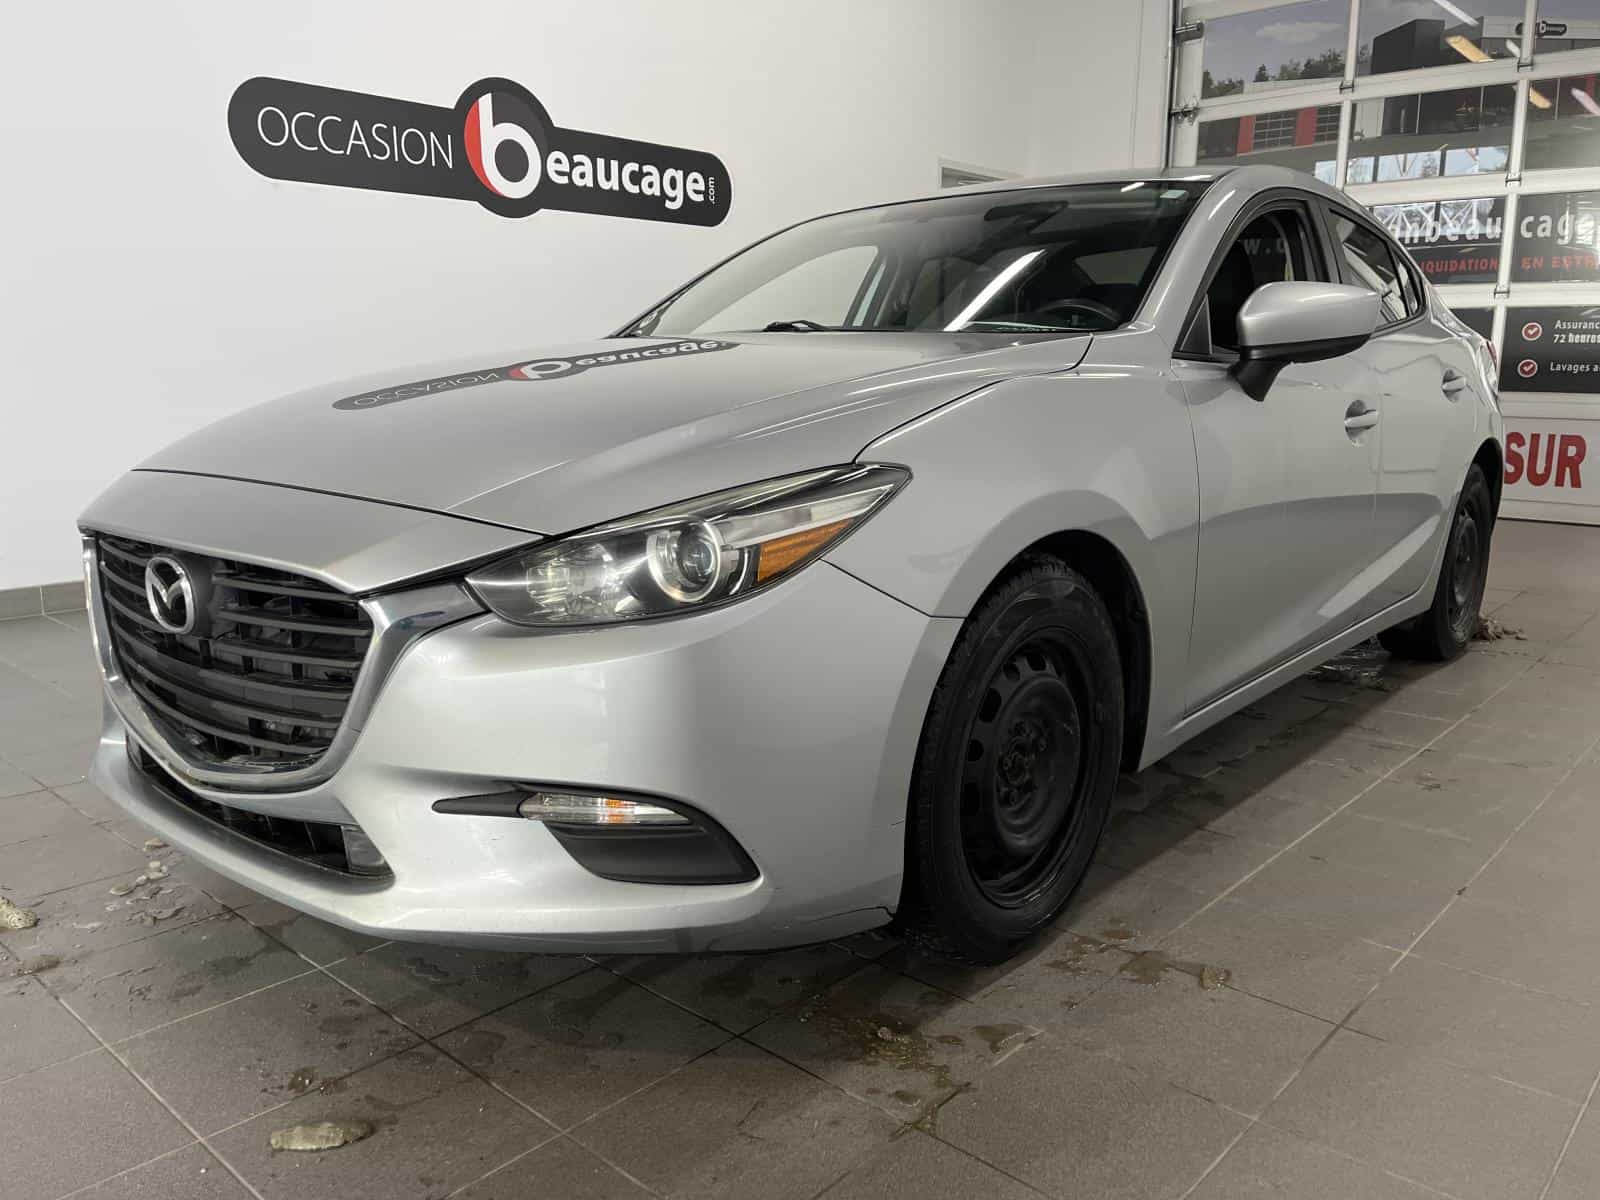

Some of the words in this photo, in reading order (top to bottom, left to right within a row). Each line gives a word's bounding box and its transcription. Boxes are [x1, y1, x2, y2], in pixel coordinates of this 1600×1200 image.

[257, 106, 453, 169] OCCASION
[476, 92, 706, 210] beaucage
[1521, 256, 1543, 270] EN
[1553, 333, 1566, 344] 72
[1550, 361, 1590, 374] Lavages
[1503, 431, 1587, 489] SUR
